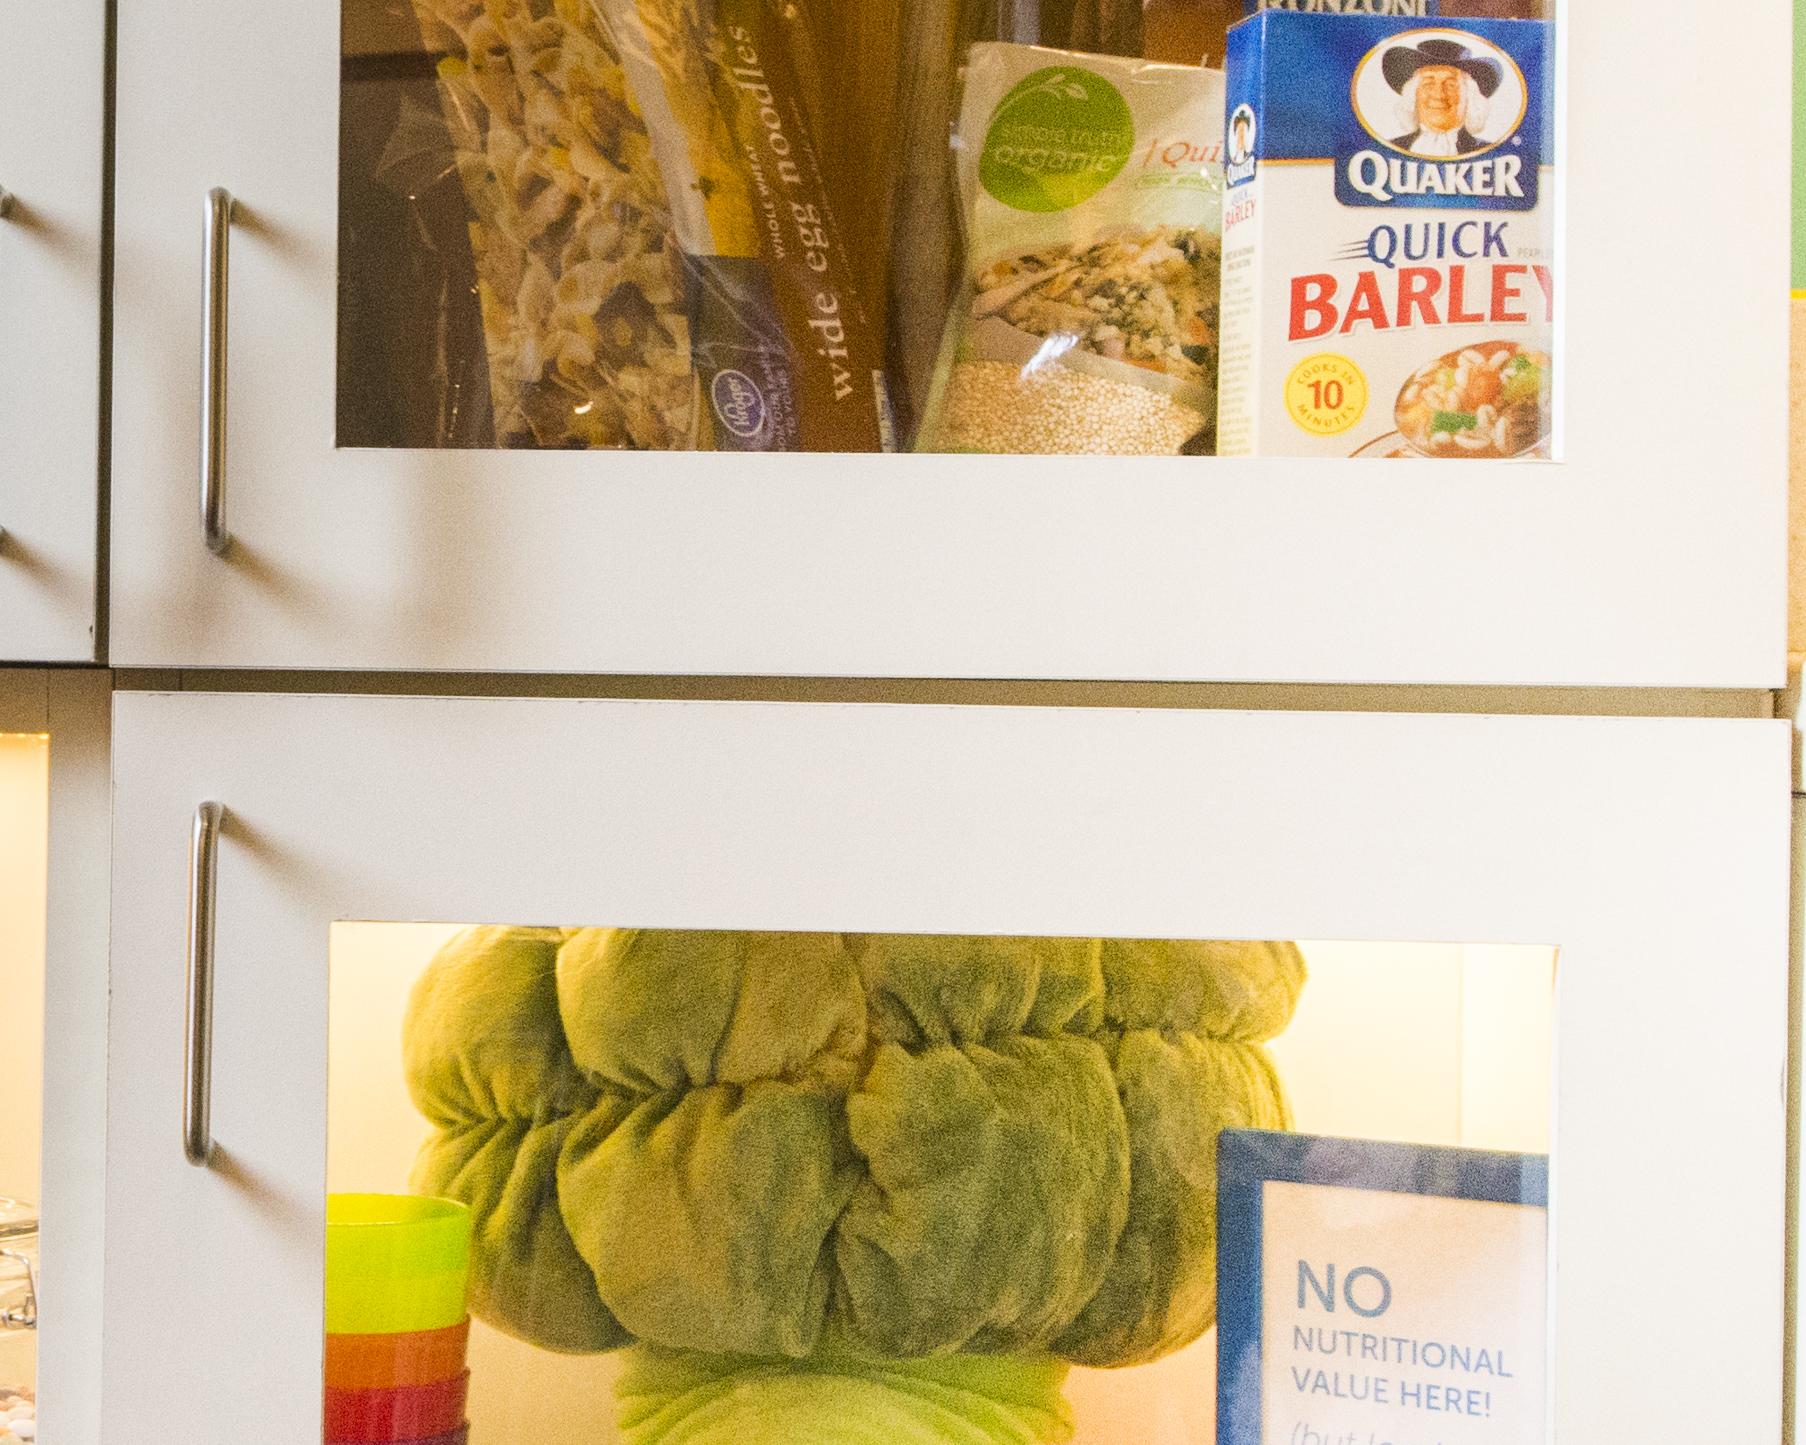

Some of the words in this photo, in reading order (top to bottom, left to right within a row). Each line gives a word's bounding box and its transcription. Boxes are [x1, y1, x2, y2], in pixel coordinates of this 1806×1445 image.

[725, 22, 803, 186] noodles
[1227, 160, 1256, 185] QUAKER
[1347, 148, 1524, 202] QUAKER
[790, 200, 831, 276] egg
[1224, 198, 1257, 233] BARLEY
[1365, 220, 1510, 269] QUICK
[806, 289, 856, 403] wide
[1296, 363, 1339, 387] COOKS
[1307, 379, 1344, 411] 10
[725, 376, 756, 427] Kroger
[1296, 404, 1356, 428] MINUTES
[1296, 1258, 1393, 1319] NO
[1292, 1324, 1514, 1379] NUTRITIONAL
[1291, 1365, 1390, 1406] VALUE
[1399, 1379, 1493, 1419] HERE!
